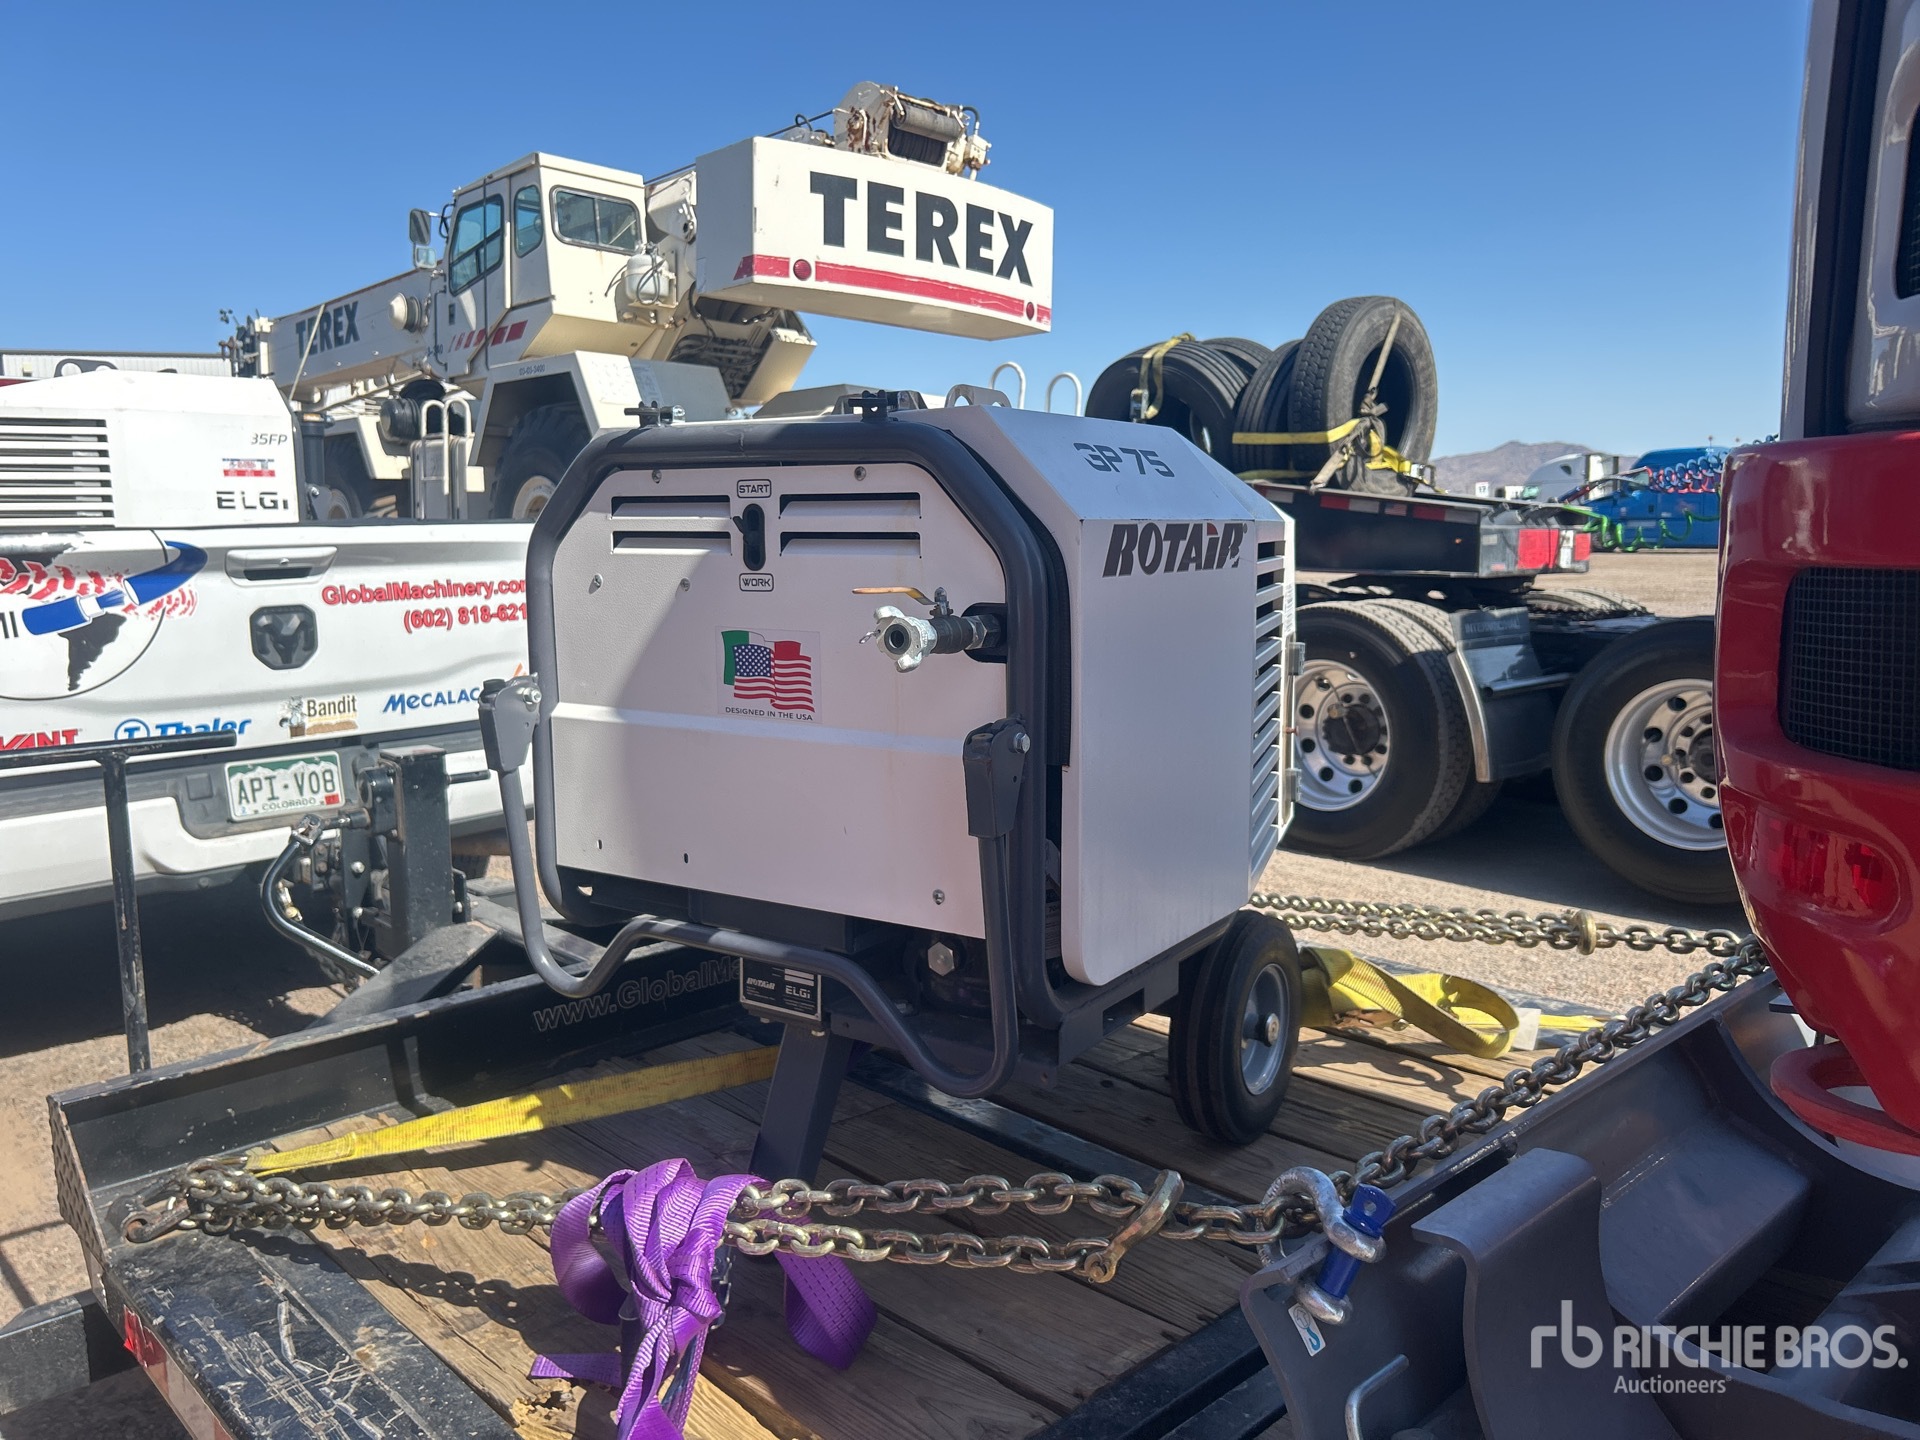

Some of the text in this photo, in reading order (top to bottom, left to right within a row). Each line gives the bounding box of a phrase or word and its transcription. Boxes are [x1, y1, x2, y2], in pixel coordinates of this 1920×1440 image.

[809, 170, 1034, 287] TEREX
[295, 300, 360, 359] TEREX
[738, 484, 770, 494] START
[741, 577, 771, 587] WORK
[403, 607, 454, 634] (602)
[306, 694, 357, 717] Bandit
[725, 706, 765, 716] DESIGNED
[778, 711, 794, 719] THE
[795, 713, 813, 721] USA
[261, 797, 317, 812] COLORADO
